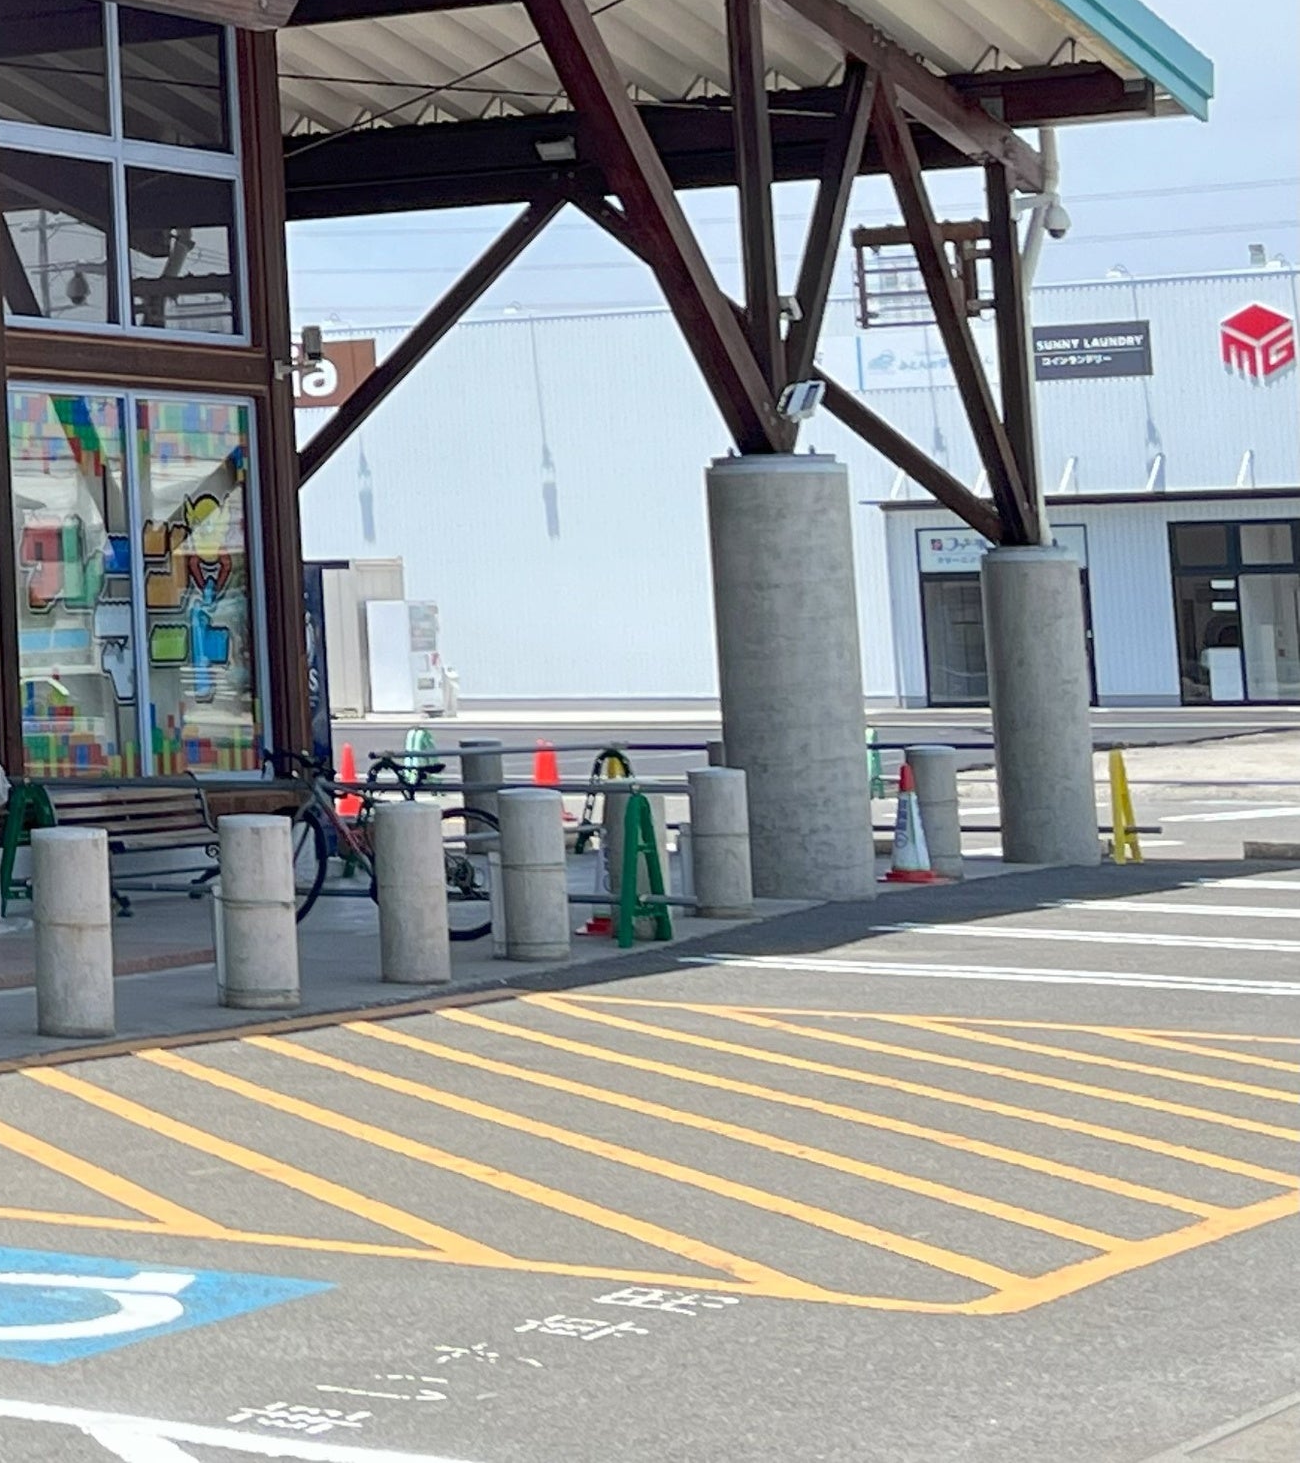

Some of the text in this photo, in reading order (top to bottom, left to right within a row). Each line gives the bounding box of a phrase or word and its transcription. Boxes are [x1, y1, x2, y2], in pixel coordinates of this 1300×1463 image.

[1036, 334, 1144, 352] SUNNY LAUNDRY
[1041, 354, 1113, 368] コインランドリー
